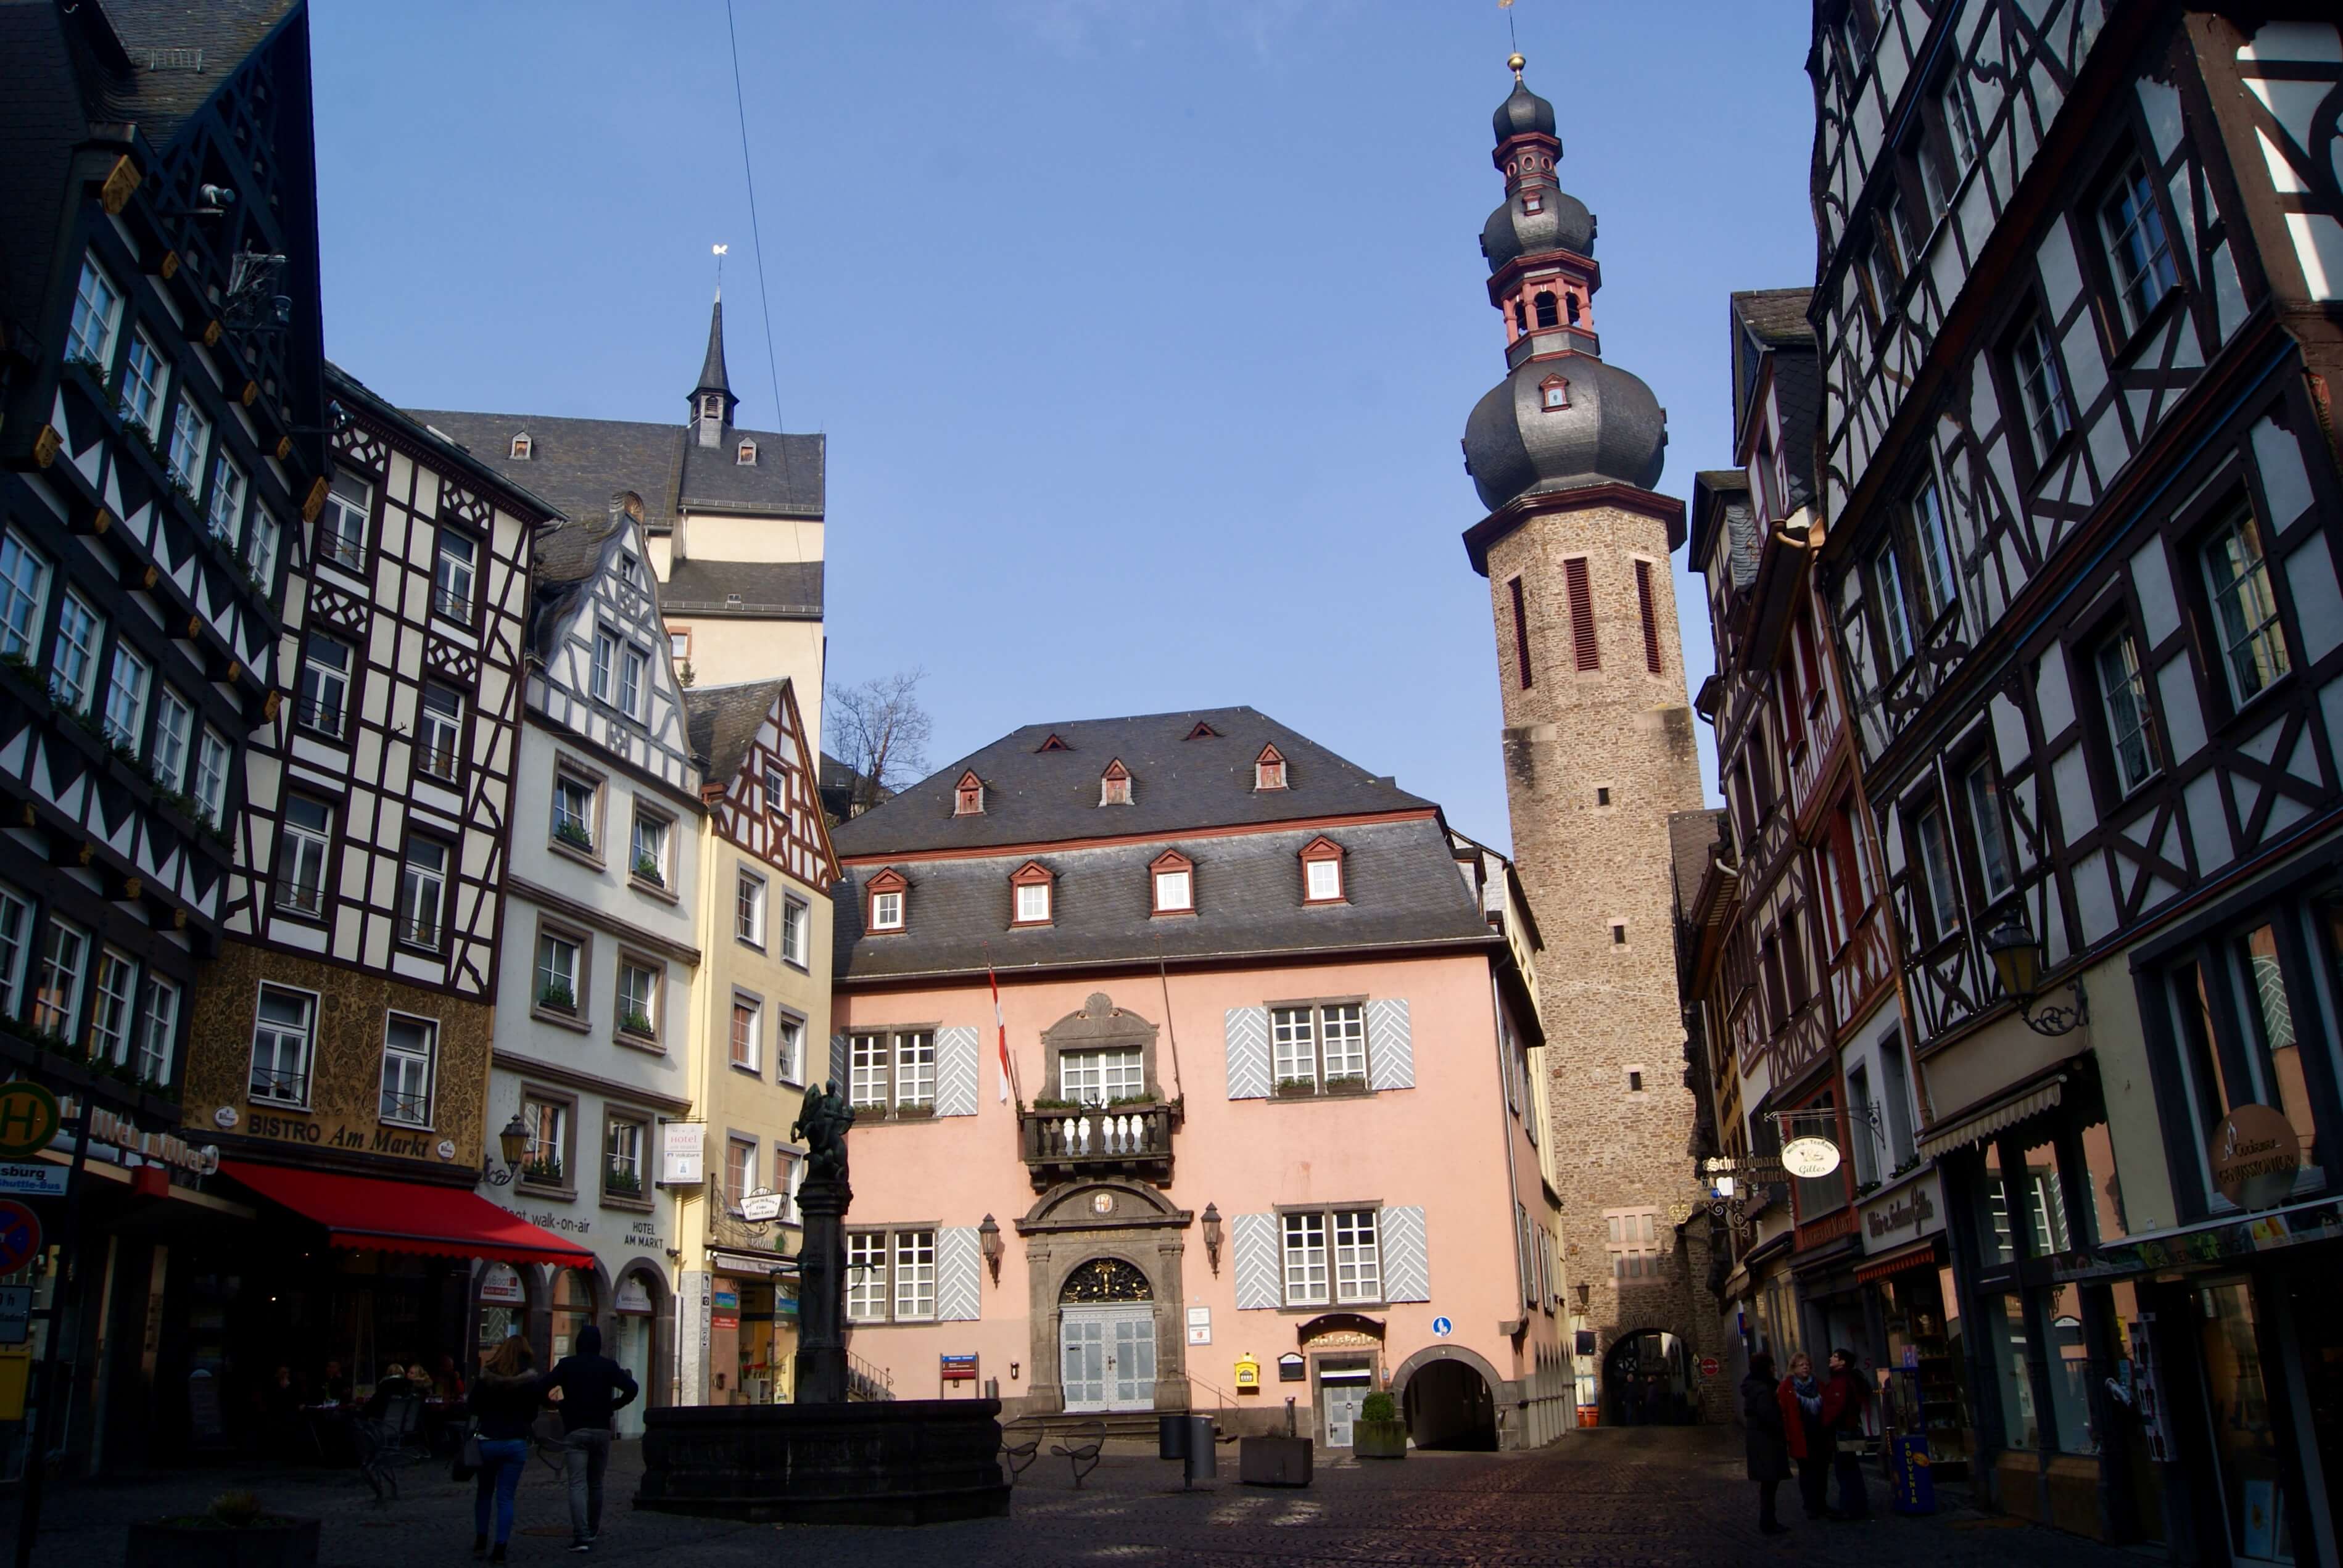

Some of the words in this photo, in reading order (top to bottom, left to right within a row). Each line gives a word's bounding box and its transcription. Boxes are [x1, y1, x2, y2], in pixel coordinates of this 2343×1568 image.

[0, 1098, 36, 1141] H
[248, 1113, 321, 1143] BISTRO
[328, 1124, 365, 1149] Am
[370, 1129, 430, 1157] Markt
[1706, 1155, 1783, 1172] Schreibware
[1799, 1165, 1826, 1174] Gilles
[632, 1221, 656, 1235] HOTEL
[1073, 1228, 1135, 1242] RATHAUS
[624, 1236, 636, 1246] AM
[638, 1237, 663, 1249] MARKT
